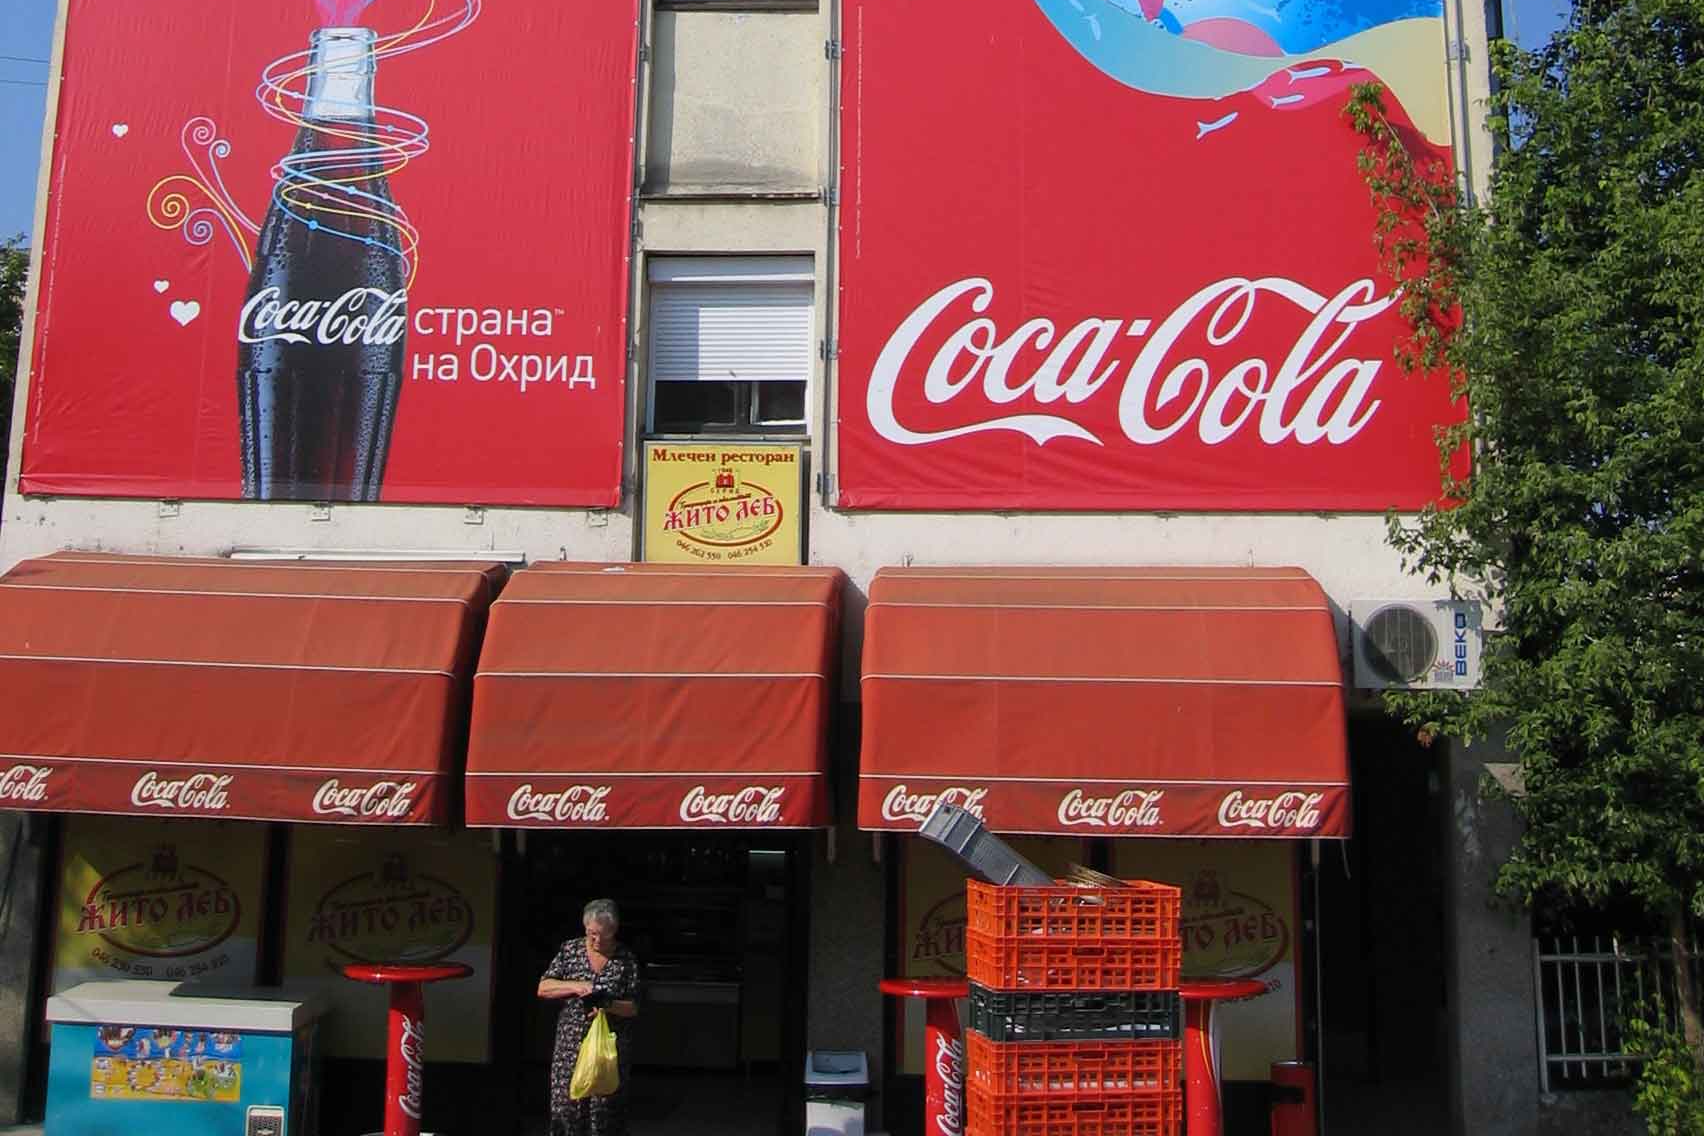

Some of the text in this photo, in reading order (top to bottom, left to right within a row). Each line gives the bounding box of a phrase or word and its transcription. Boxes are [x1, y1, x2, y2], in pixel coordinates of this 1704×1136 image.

[238, 287, 408, 345] Coca-Cola
[412, 344, 597, 392] на Охрид
[866, 277, 1404, 446] Coca-Cola
[653, 449, 794, 466] Млечен ресторан
[664, 505, 730, 529] ЖИТО
[736, 496, 776, 520] ЛЕБ
[1455, 613, 1467, 676] BEKO
[132, 771, 234, 809] Coca-Cola
[312, 779, 417, 817] Coca-Cola
[507, 784, 612, 821] Coca-Cola
[679, 786, 785, 822] Coca-Cola
[881, 784, 988, 823] Coca-Cla
[1057, 789, 1164, 826] Coca-Cola
[1218, 790, 1324, 828] Coca-Cola
